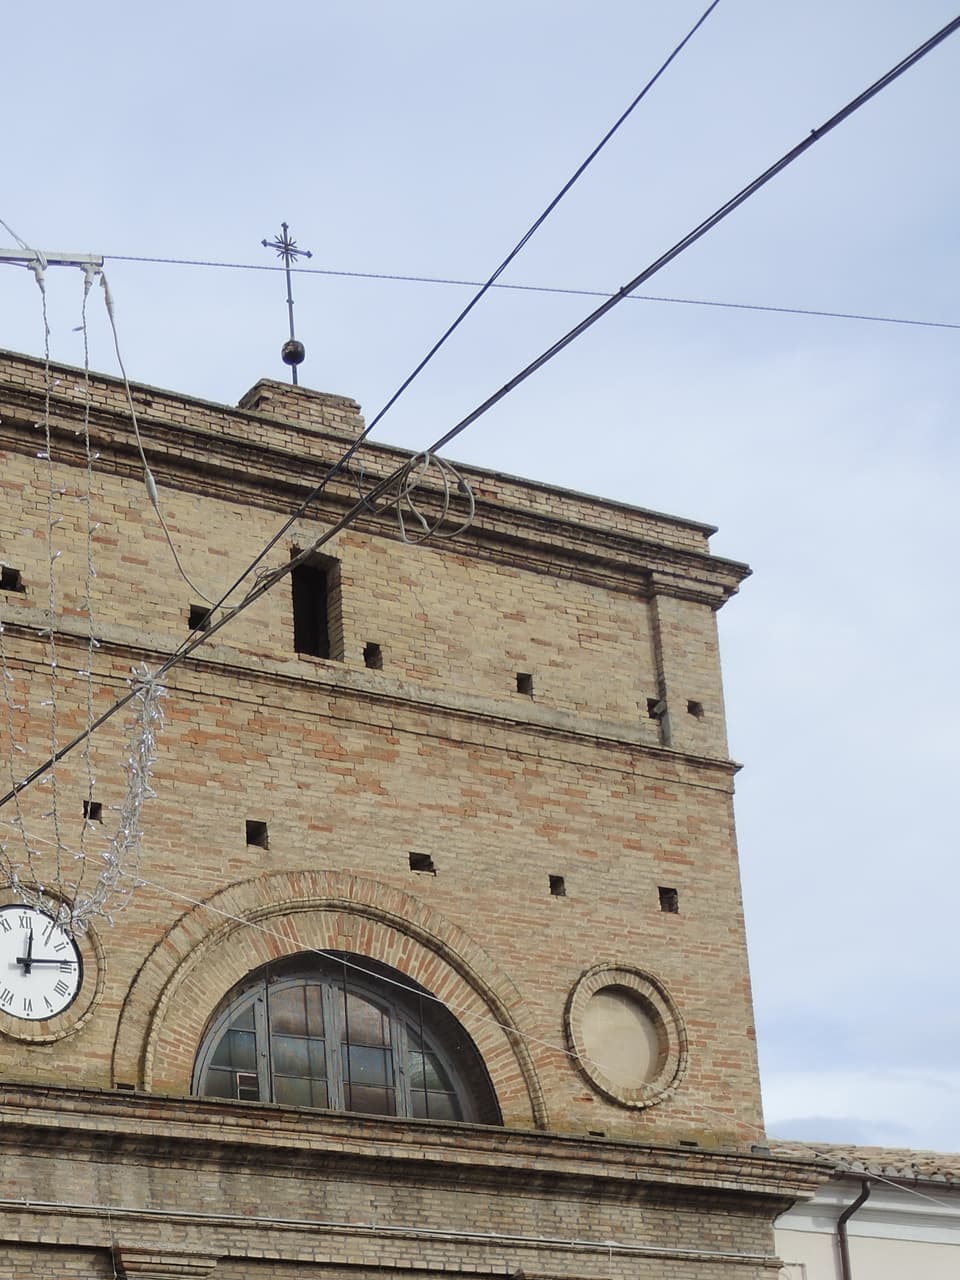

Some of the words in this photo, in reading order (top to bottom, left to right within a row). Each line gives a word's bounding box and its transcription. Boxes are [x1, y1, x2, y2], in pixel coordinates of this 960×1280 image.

[19, 915, 32, 929] XII
[53, 942, 66, 953] II
[0, 988, 14, 1006] VII
[44, 996, 52, 1009] V
[23, 998, 33, 1012] VI
